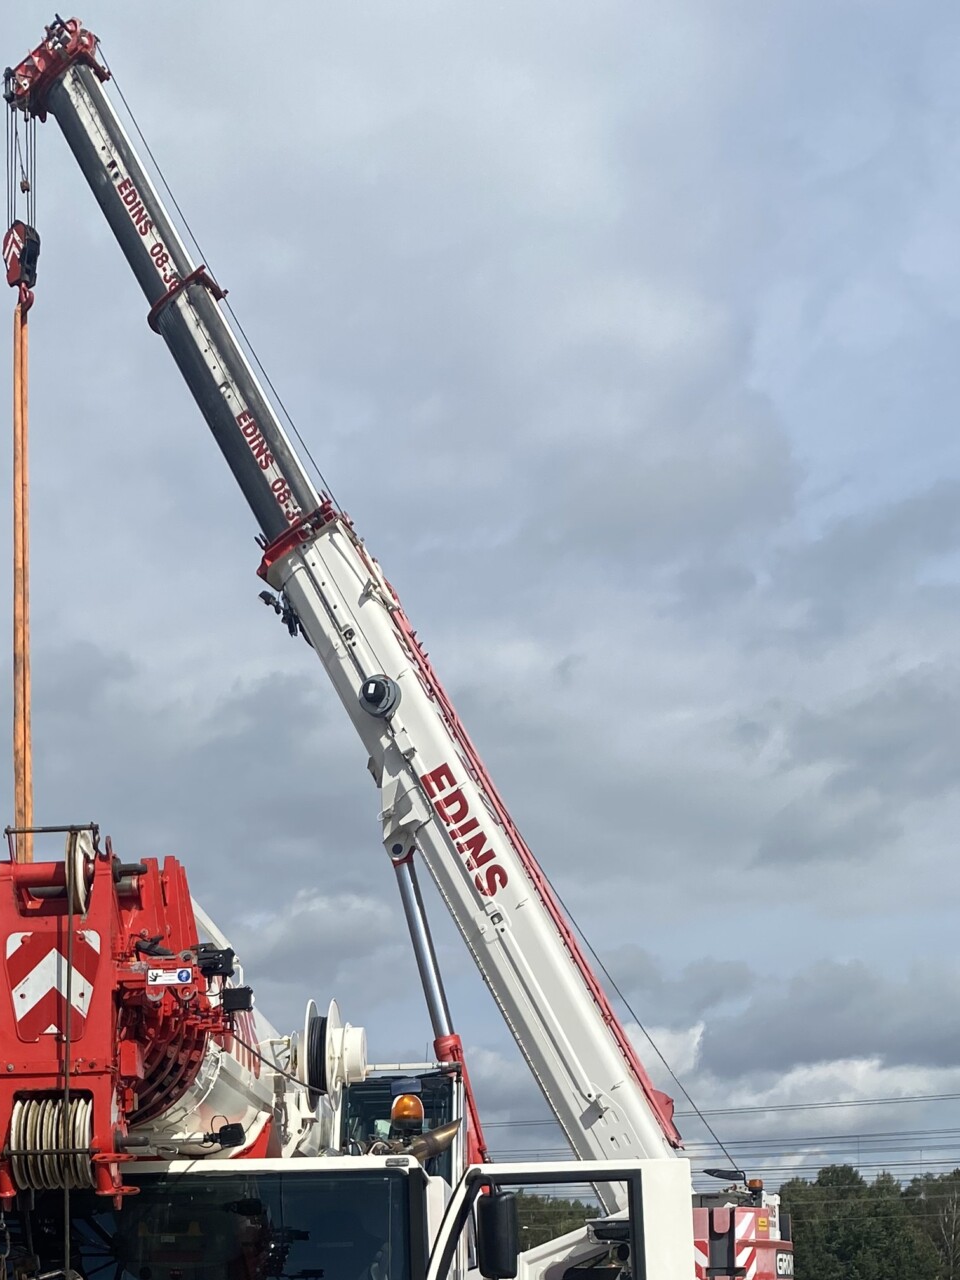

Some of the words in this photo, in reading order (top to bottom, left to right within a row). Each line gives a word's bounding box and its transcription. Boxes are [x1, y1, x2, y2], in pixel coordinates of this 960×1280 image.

[117, 177, 154, 236] EDINS
[236, 410, 274, 470] EDINS
[420, 762, 508, 897] EDINS
